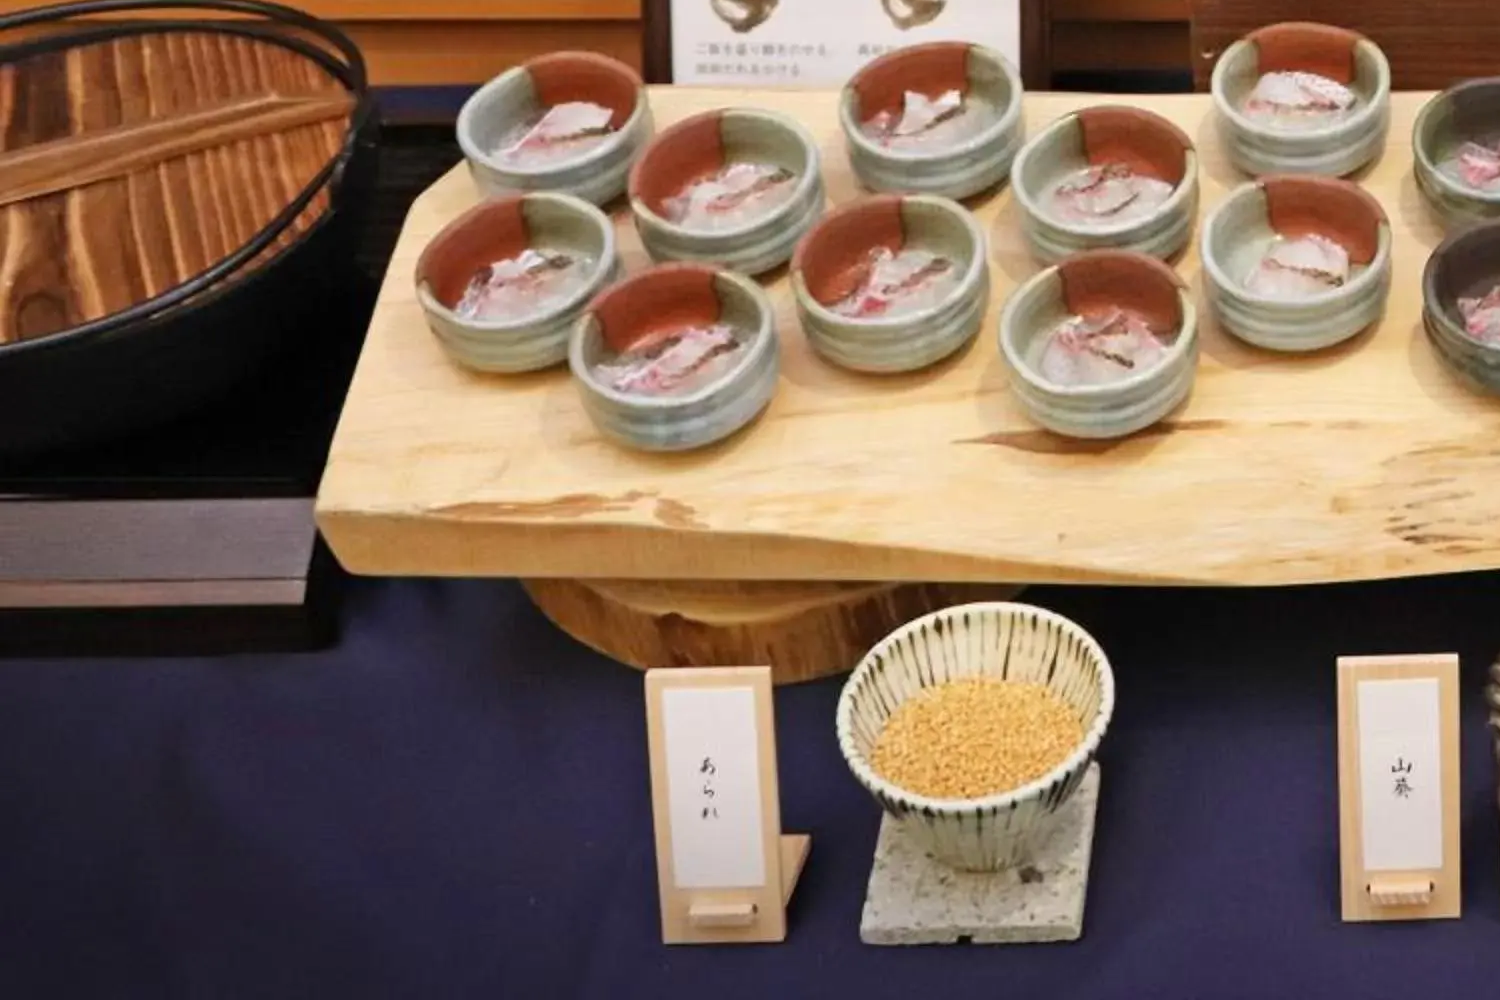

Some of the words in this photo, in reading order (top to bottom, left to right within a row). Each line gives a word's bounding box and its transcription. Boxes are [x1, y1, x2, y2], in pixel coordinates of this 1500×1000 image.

[699, 756, 721, 819] あられ
[1391, 756, 1414, 799] 山葵
